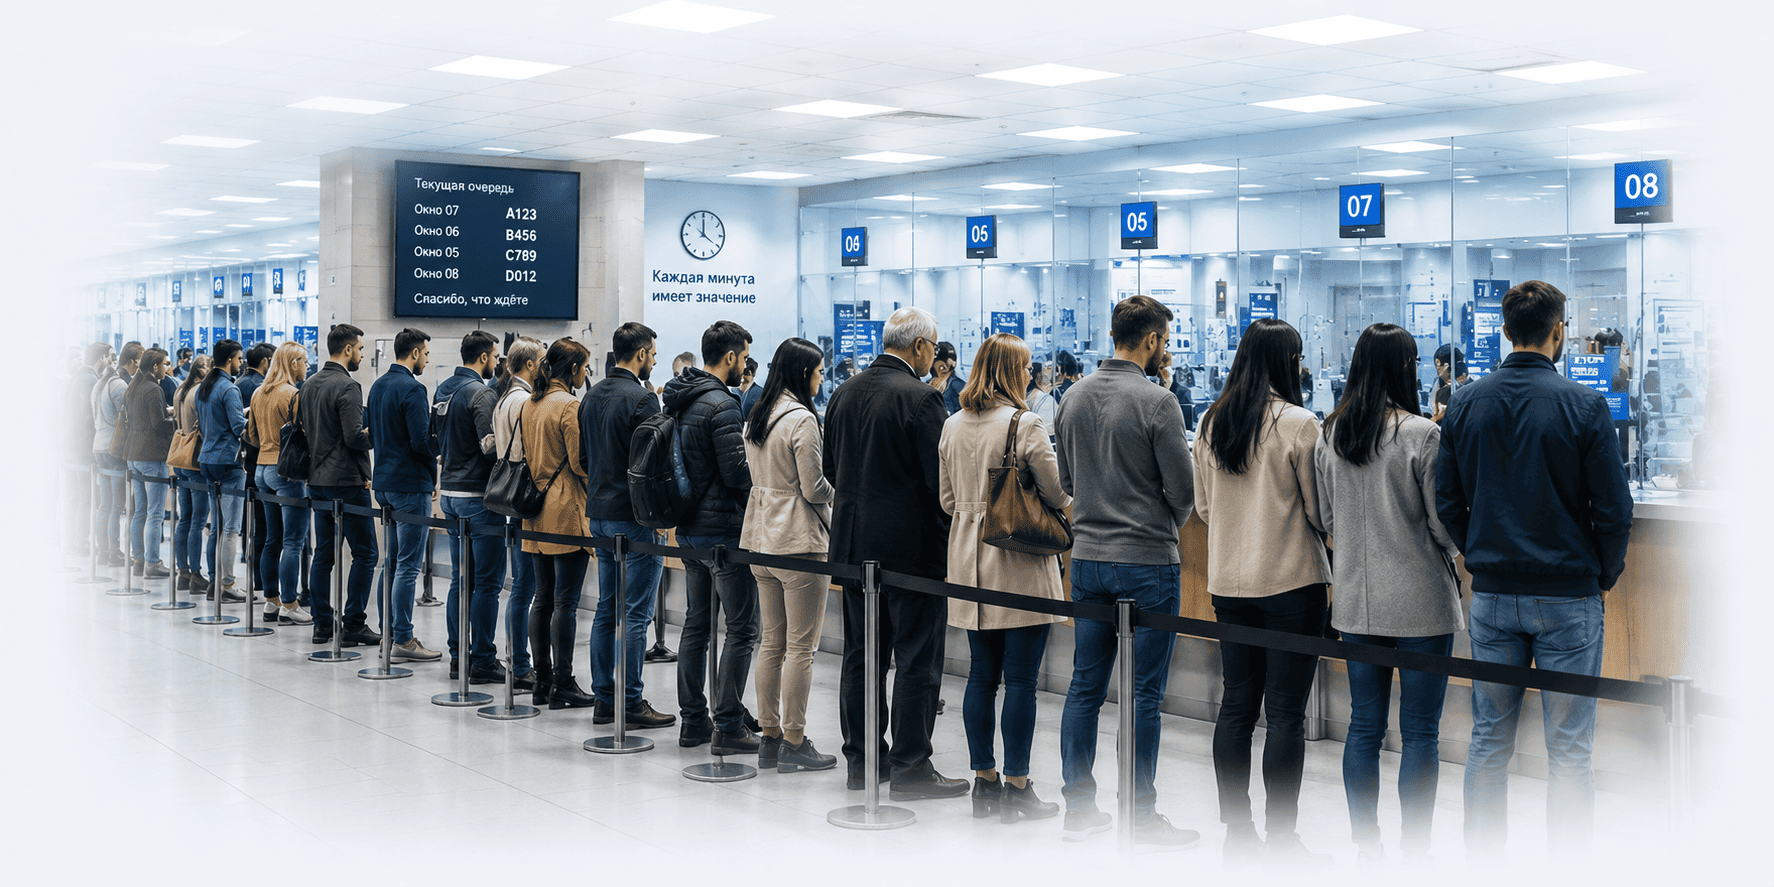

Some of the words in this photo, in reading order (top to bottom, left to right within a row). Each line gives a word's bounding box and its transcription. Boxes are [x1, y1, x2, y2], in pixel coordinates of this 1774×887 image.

[414, 177, 465, 193] Текущая
[467, 182, 515, 196] очередь
[1625, 172, 1659, 200] 08
[414, 203, 443, 216] Окно
[445, 204, 460, 216] 07
[505, 206, 537, 221] A123
[1347, 194, 1373, 218] 07
[1127, 211, 1148, 232] 05
[414, 224, 443, 237] Окно
[445, 225, 460, 237] 06
[505, 228, 537, 242] B456
[414, 245, 443, 258] Окно
[445, 246, 460, 258] 05
[505, 249, 537, 262] C789
[413, 267, 443, 280] Окно
[444, 267, 460, 280] 08
[505, 270, 537, 283] D012
[652, 269, 704, 285] Каждая
[707, 274, 756, 288] минута
[471, 295, 491, 305] что
[652, 292, 693, 302] имеет
[695, 293, 756, 304] значение
